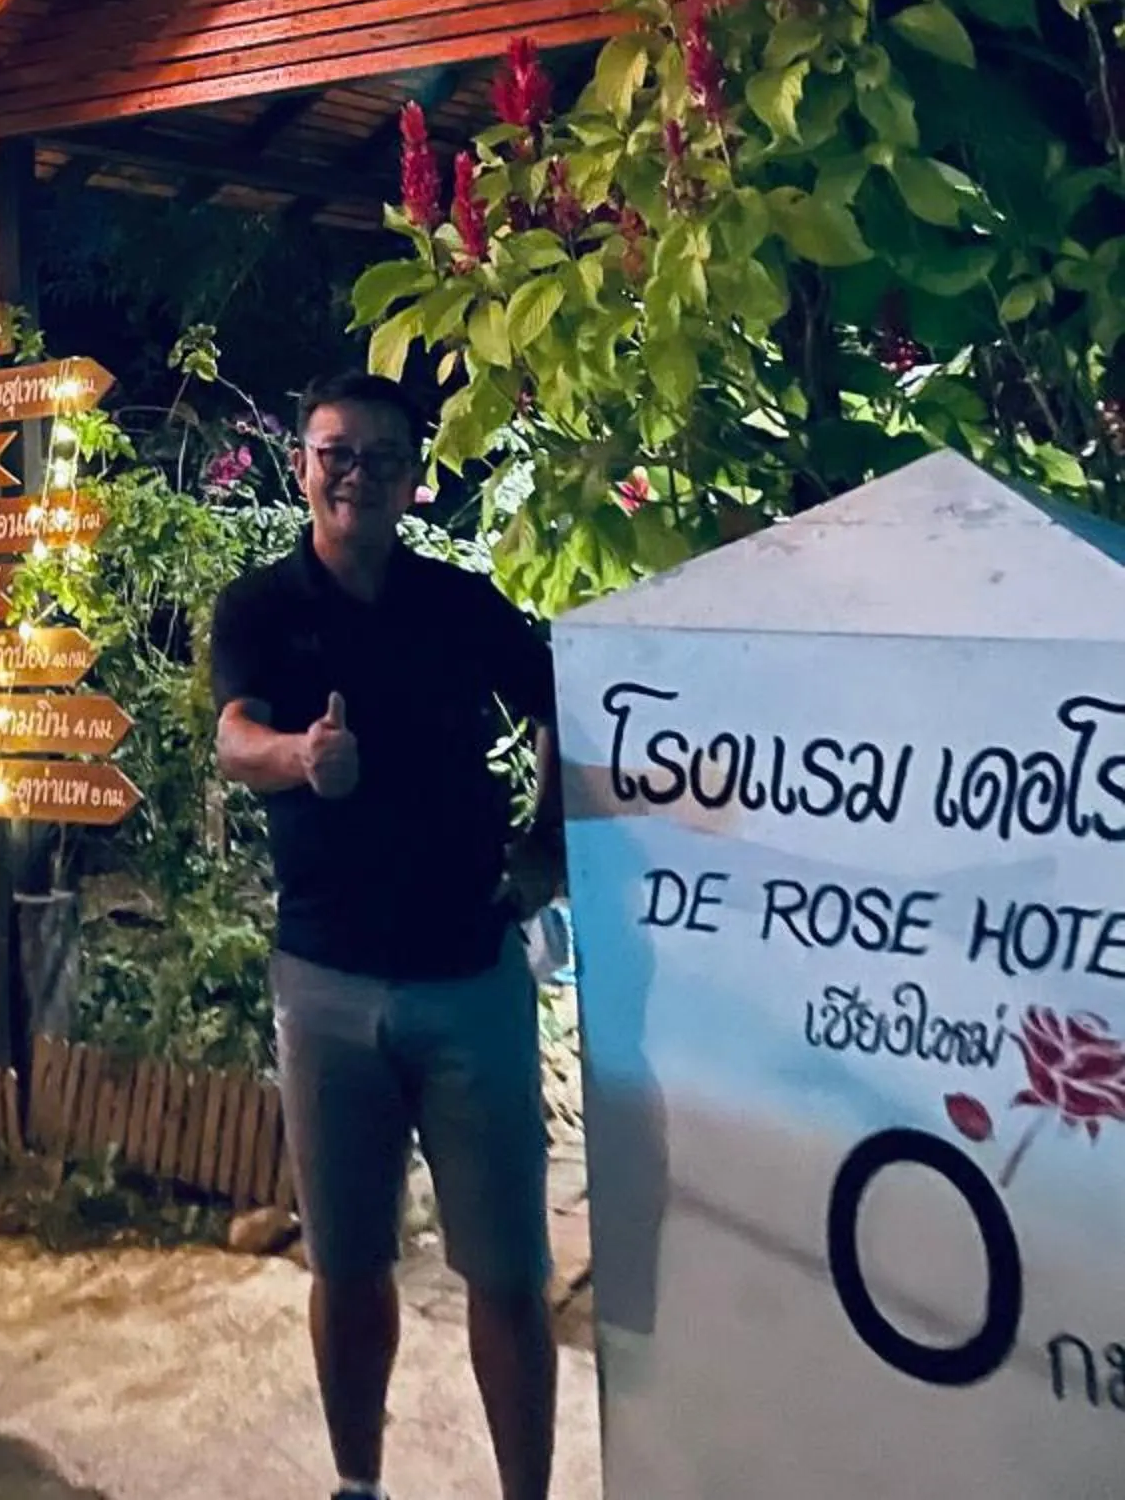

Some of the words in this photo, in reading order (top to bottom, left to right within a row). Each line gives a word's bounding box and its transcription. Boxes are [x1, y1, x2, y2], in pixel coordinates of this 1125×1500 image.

[602, 681, 913, 824] โรงแรม
[638, 868, 731, 934] DE
[759, 878, 942, 956] ROSE
[968, 896, 1125, 979] HOTE
[805, 981, 1008, 1069] เชียงใหม่
